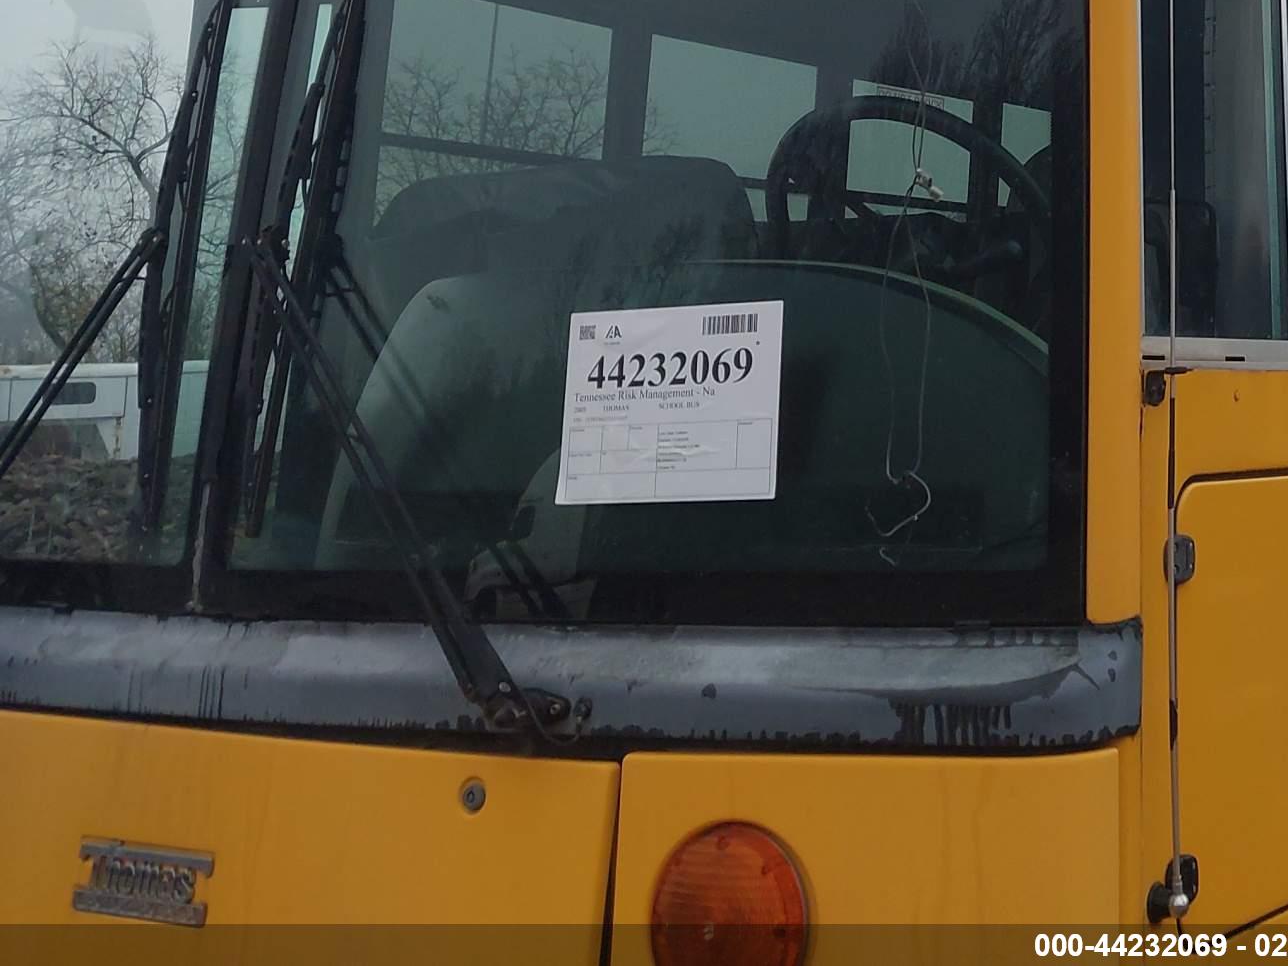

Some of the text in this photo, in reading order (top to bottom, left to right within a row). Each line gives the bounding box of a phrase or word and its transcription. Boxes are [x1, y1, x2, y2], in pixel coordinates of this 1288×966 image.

[587, 347, 753, 389] 44232069
[575, 393, 616, 403] Tennessee
[618, 390, 637, 401] Risk
[639, 386, 694, 401] Management
[702, 387, 715, 397] Na
